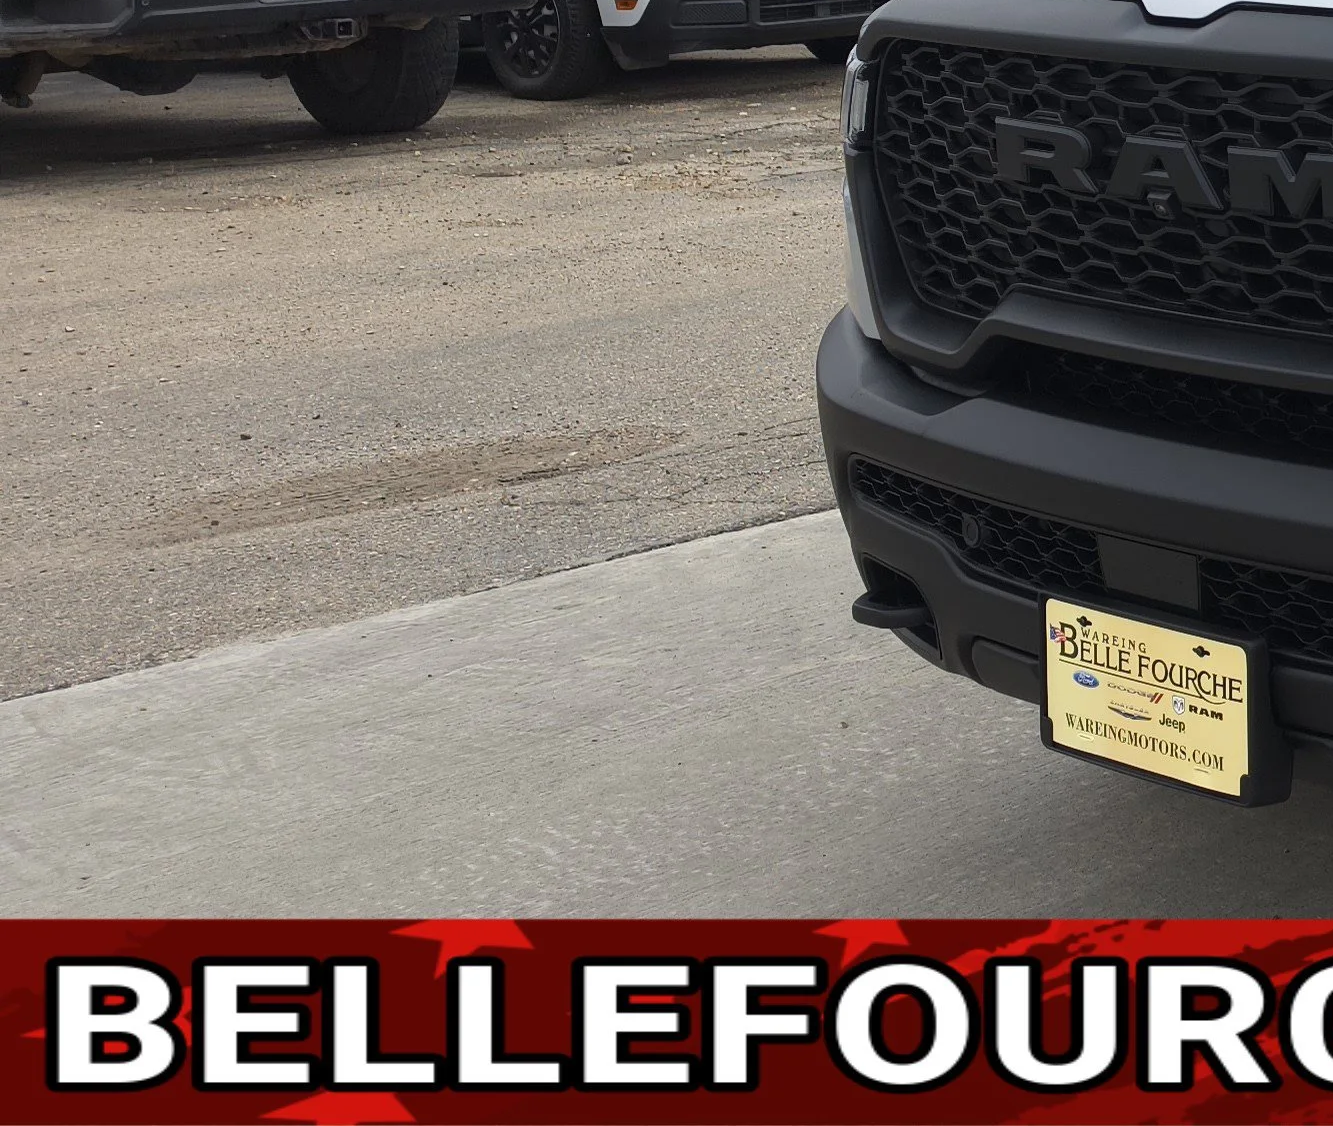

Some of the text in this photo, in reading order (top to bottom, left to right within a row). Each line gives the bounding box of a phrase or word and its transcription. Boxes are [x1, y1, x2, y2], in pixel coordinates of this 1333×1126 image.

[1081, 626, 1148, 654] WAREING
[1059, 621, 1244, 704] BELLE FOURCHE
[1158, 713, 1186, 733] Jeep
[1188, 704, 1224, 721] RAM
[1065, 712, 1224, 772] WAREINGMOTORS.COM
